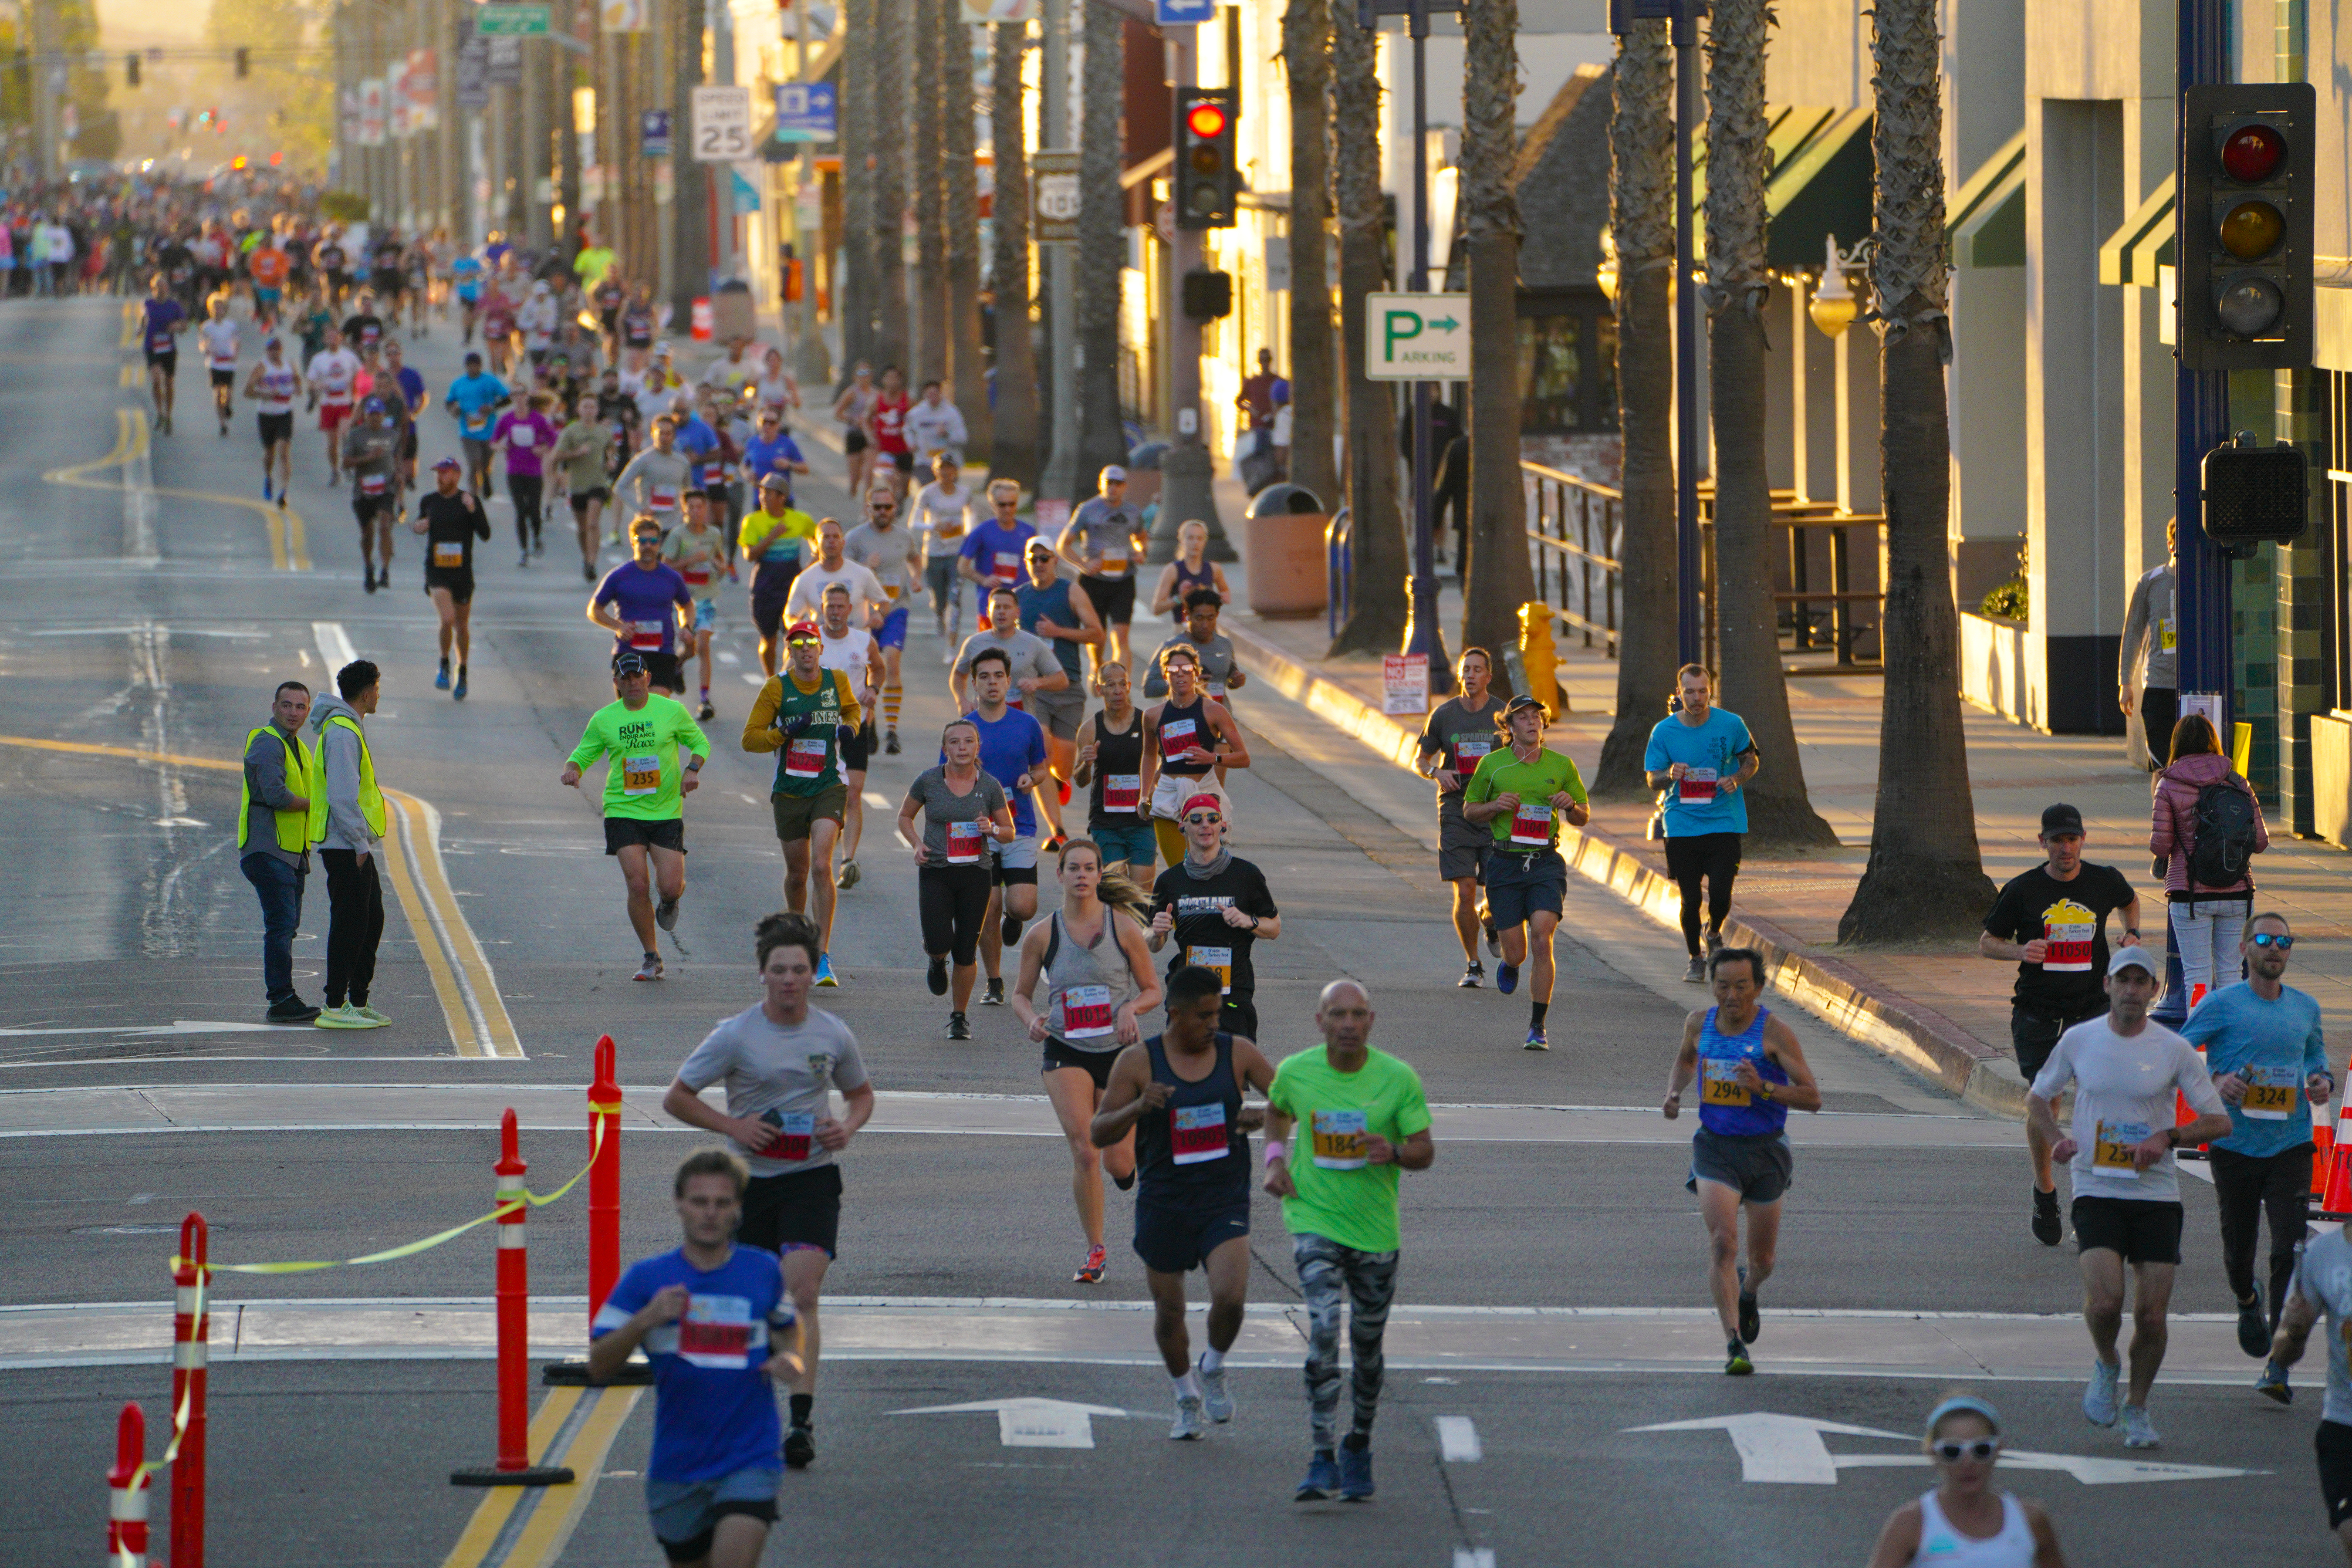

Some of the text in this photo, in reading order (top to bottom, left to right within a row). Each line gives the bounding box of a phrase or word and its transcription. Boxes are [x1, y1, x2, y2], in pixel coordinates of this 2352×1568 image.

[702, 126, 744, 153] 25
[1387, 666, 1403, 678] NO
[619, 723, 645, 736] RUN
[619, 732, 655, 740] ENDURANCE
[625, 738, 655, 749] Race
[1460, 733, 1494, 742] SPARTAN
[793, 754, 825, 767] 10798
[1460, 757, 1477, 769] 105
[632, 772, 654, 785] 235
[1517, 820, 1548, 834] 11041
[2048, 943, 2091, 957] 11050
[1069, 1006, 1110, 1024] 11015
[1713, 1082, 1741, 1099] 294
[2256, 1087, 2286, 1105] 324
[1179, 1126, 1225, 1147] 10905
[770, 1136, 809, 1153] 0304
[1325, 1135, 1356, 1153] 184
